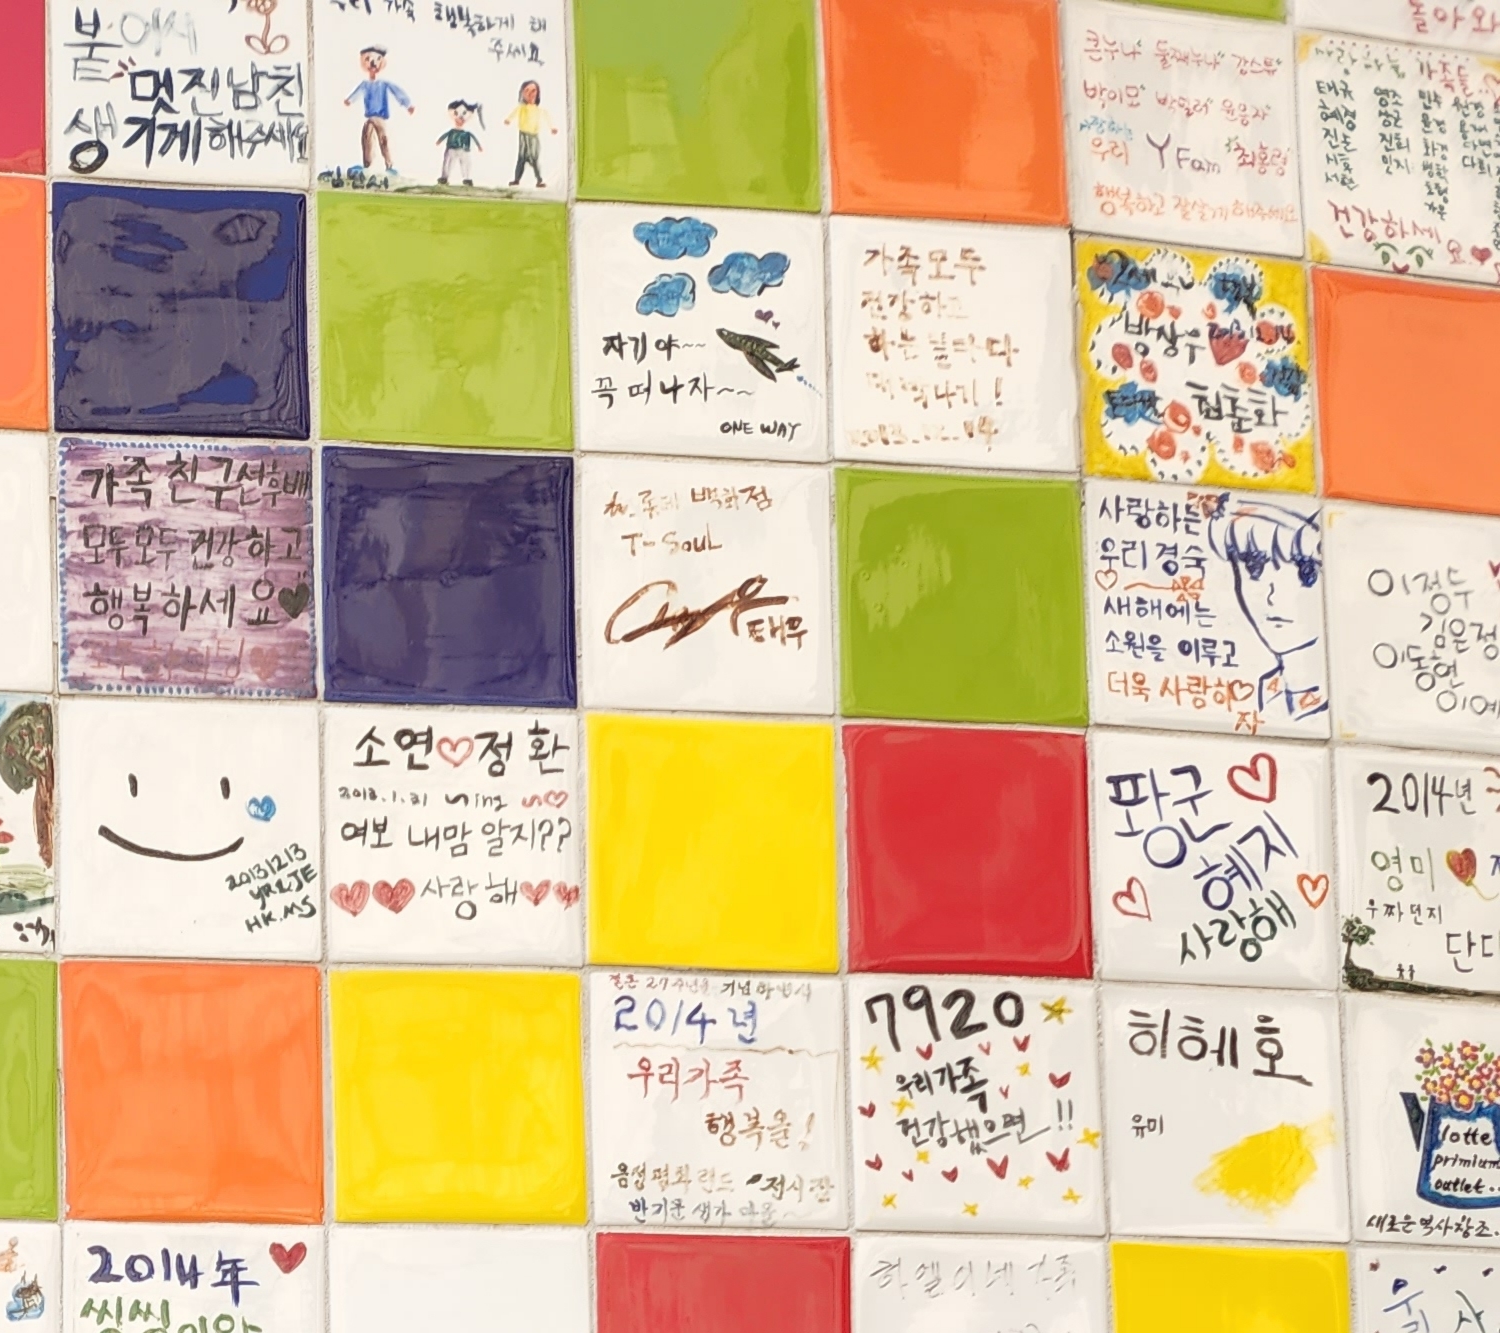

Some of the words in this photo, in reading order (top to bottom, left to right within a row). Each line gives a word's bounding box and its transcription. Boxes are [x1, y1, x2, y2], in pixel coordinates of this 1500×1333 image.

[591, 375, 617, 409] 꼭
[720, 419, 752, 437] ONE
[760, 420, 801, 442] WAY
[82, 456, 153, 507] 가족
[1099, 495, 1202, 536] 사랑하는
[1099, 539, 1147, 573] 우리
[1155, 542, 1207, 582] 경숙
[83, 577, 279, 636] 행복하세요
[1103, 597, 1217, 627] 새해에는
[1105, 630, 1167, 662] 소원을
[1178, 637, 1239, 668] 이루고
[1108, 670, 1151, 700] 더욱
[354, 725, 433, 770] 소연
[474, 719, 570, 777] 정환
[1366, 771, 1477, 818] 2014년
[341, 815, 393, 849] 여보
[408, 821, 472, 858] 내맘
[481, 816, 572, 858] 알지??
[1371, 845, 1435, 892] 영미
[420, 872, 518, 921] 사랑해
[1180, 889, 1297, 966] 사랑해
[864, 984, 1024, 1052] 7920
[1127, 1008, 1313, 1087] 히헤호
[895, 1055, 989, 1114] 우리가족
[1131, 1114, 1164, 1139] 유미
[1441, 1124, 1493, 1145] lotte
[87, 1245, 261, 1307] 2014年
